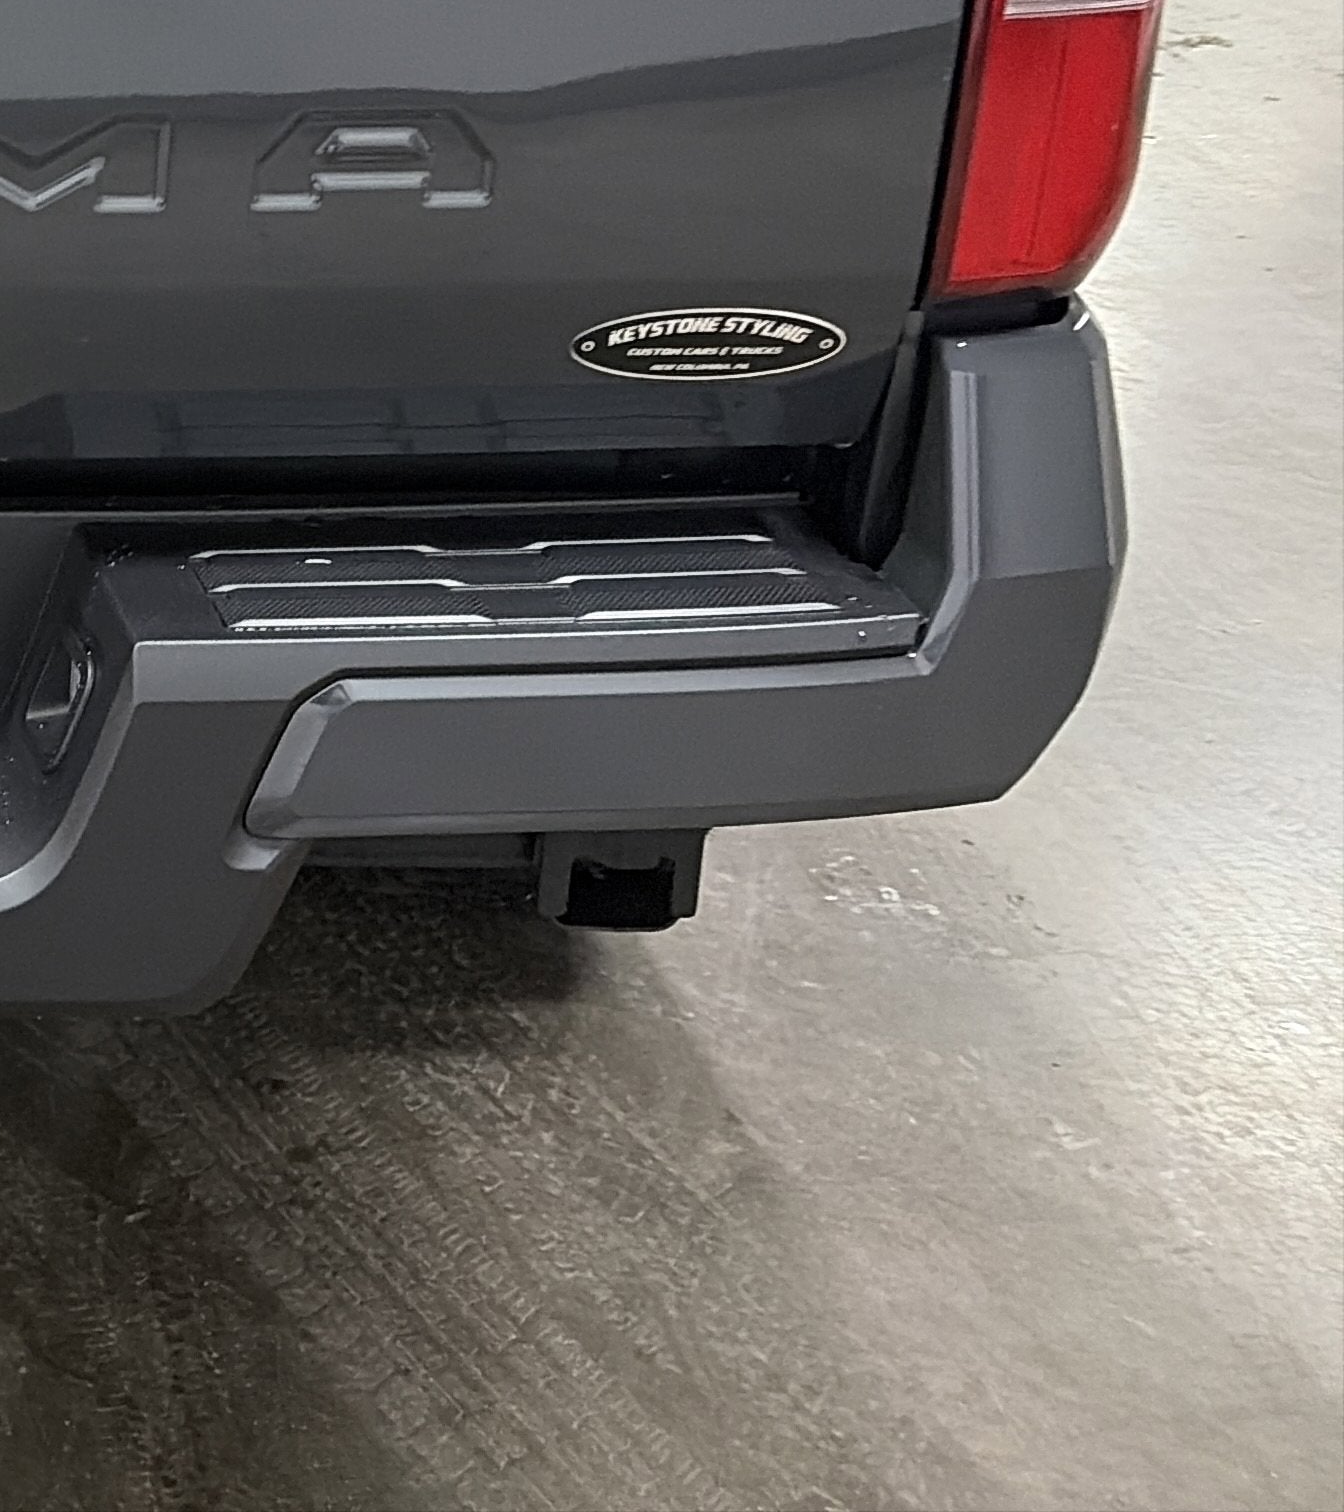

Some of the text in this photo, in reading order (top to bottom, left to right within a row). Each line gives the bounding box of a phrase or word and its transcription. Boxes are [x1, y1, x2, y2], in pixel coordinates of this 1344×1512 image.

[607, 316, 814, 347] KEYSTONE STYLING
[626, 347, 682, 357] CUSTOM
[730, 346, 784, 356] TRUCKS
